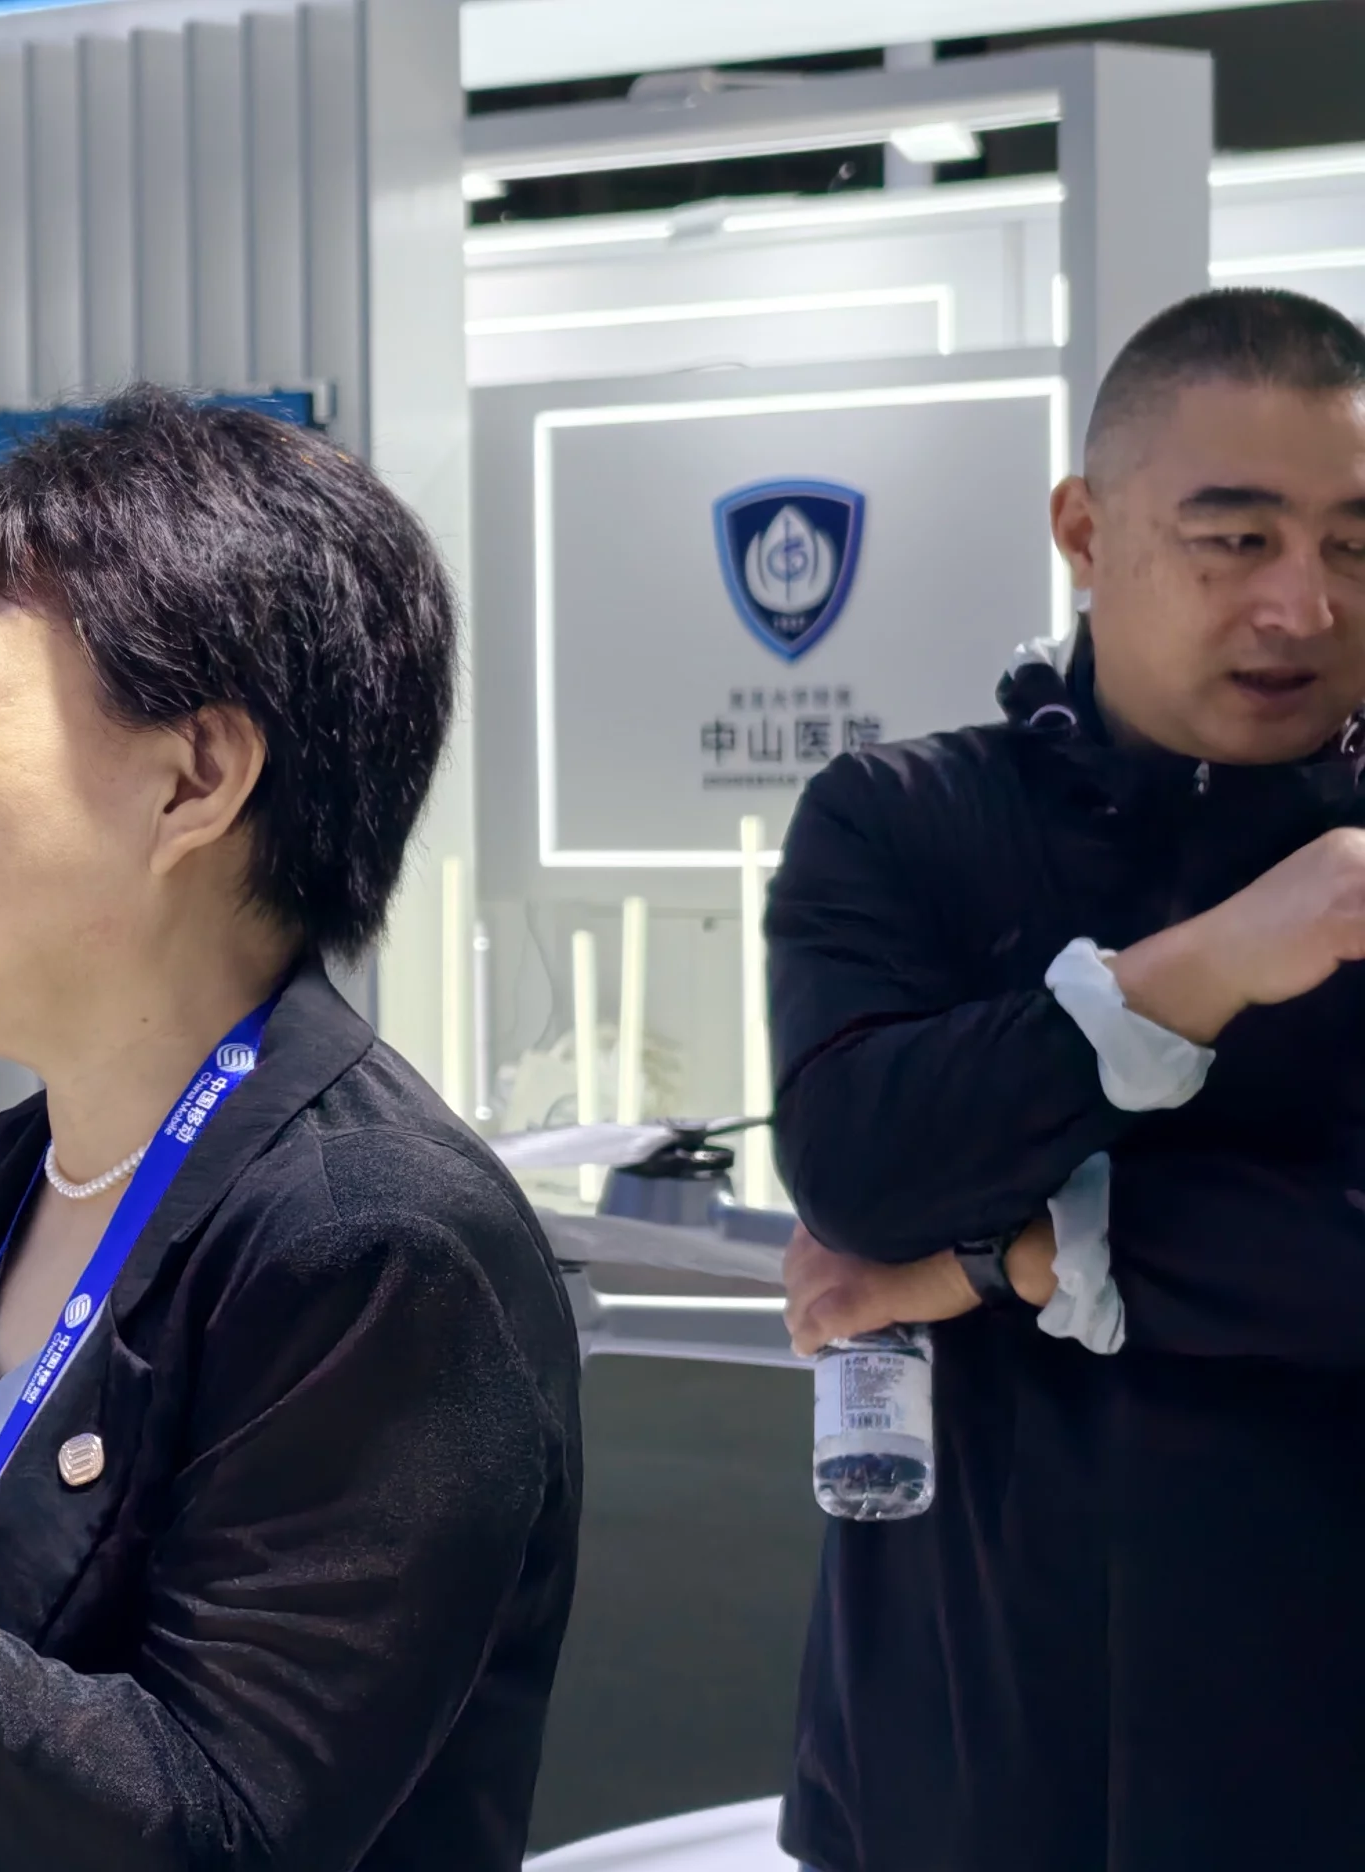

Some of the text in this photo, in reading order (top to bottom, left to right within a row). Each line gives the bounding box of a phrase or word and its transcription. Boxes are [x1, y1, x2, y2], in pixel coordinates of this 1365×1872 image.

[701, 715, 881, 767] 中山医院
[164, 1072, 213, 1135] China Mobile
[175, 1077, 228, 1144] 中国移动
[26, 1335, 71, 1404] 中国移动
